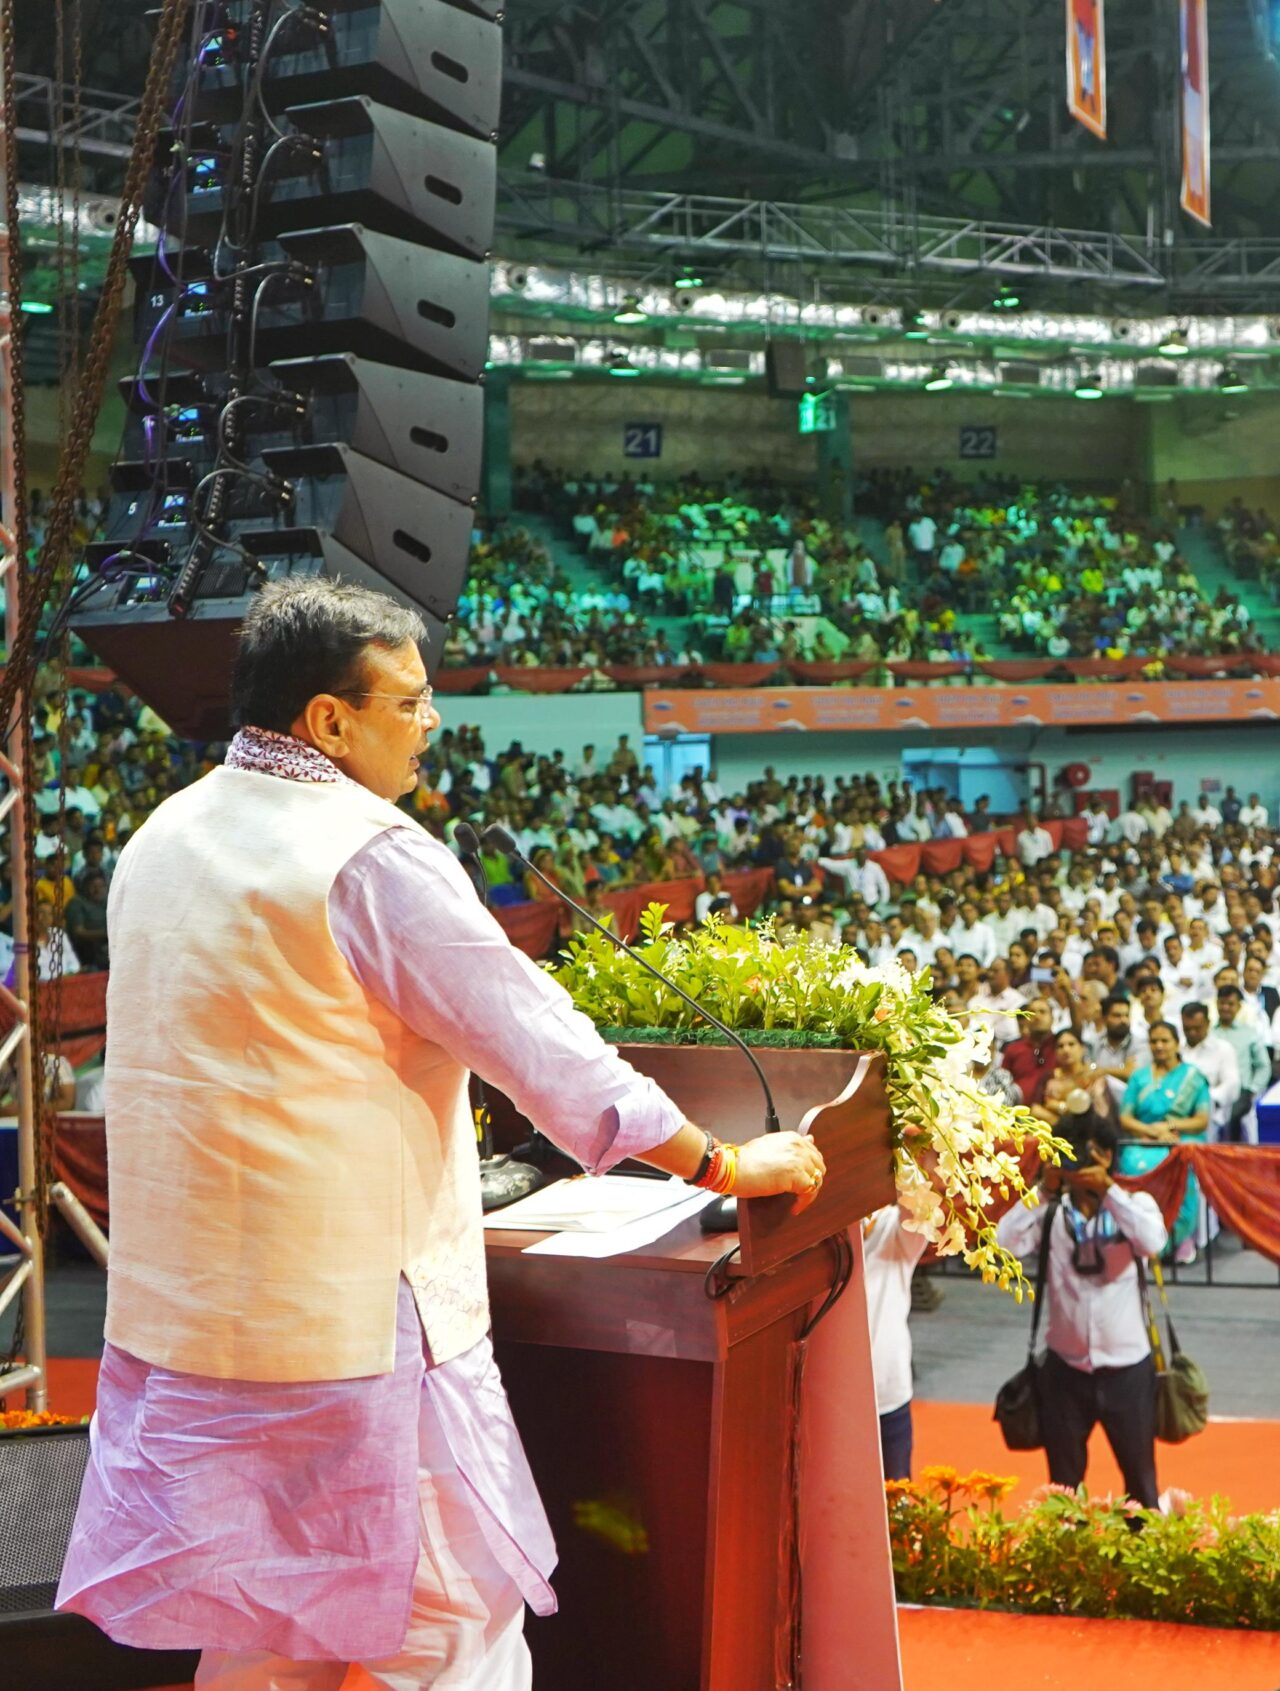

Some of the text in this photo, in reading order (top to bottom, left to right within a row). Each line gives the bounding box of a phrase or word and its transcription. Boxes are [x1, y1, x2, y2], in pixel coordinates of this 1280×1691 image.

[150, 294, 165, 308] 13
[626, 428, 658, 453] 21
[962, 431, 994, 455] 22
